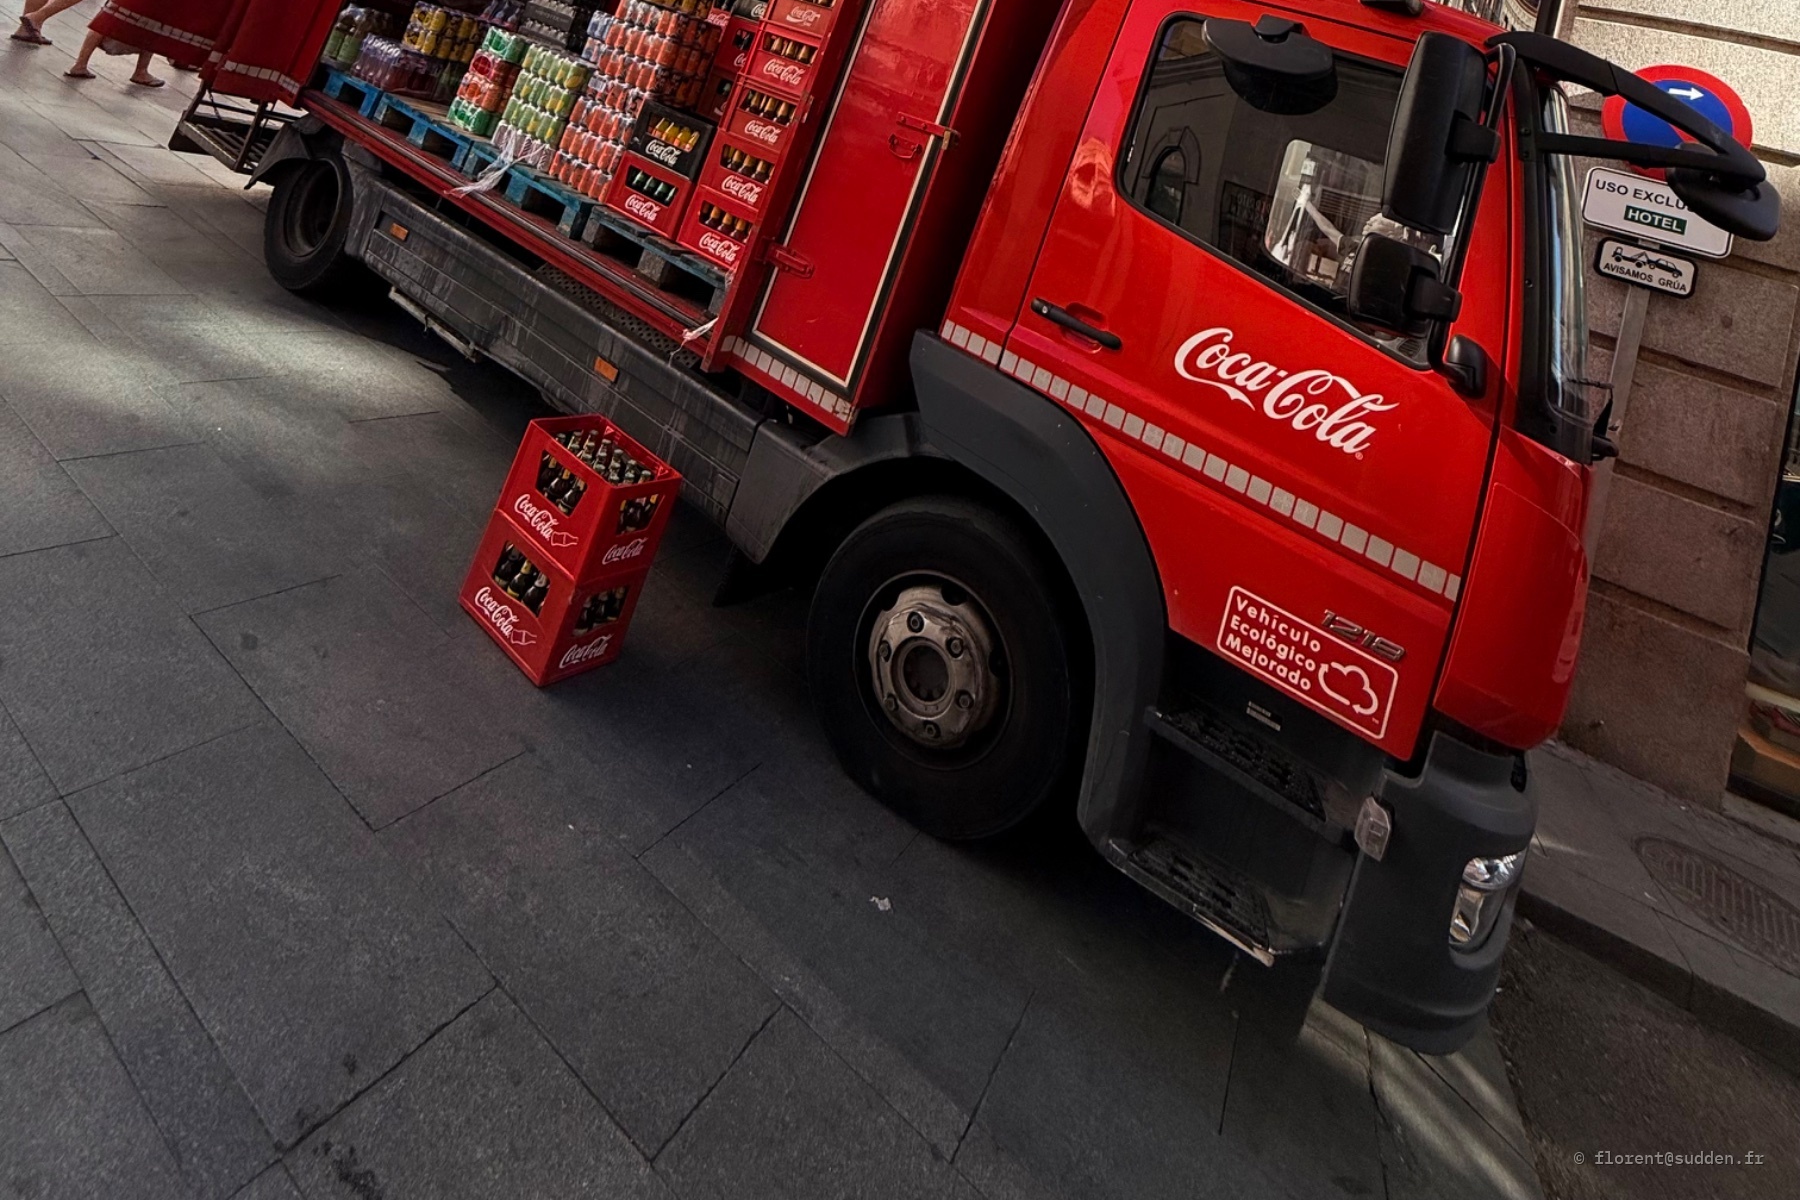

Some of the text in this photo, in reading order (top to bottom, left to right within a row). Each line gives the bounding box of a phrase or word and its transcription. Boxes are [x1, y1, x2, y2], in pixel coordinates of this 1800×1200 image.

[1595, 178, 1694, 212] USO EXCLU
[1627, 208, 1682, 232] HOTEL
[1603, 262, 1687, 293] AVISAMOS GRÚA
[1174, 327, 1400, 457] Coca-Cola
[1230, 615, 1316, 672] Ecológico
[1236, 595, 1321, 653] Vehículo
[1321, 608, 1406, 662] 1218
[1225, 633, 1311, 691] Mejorado
